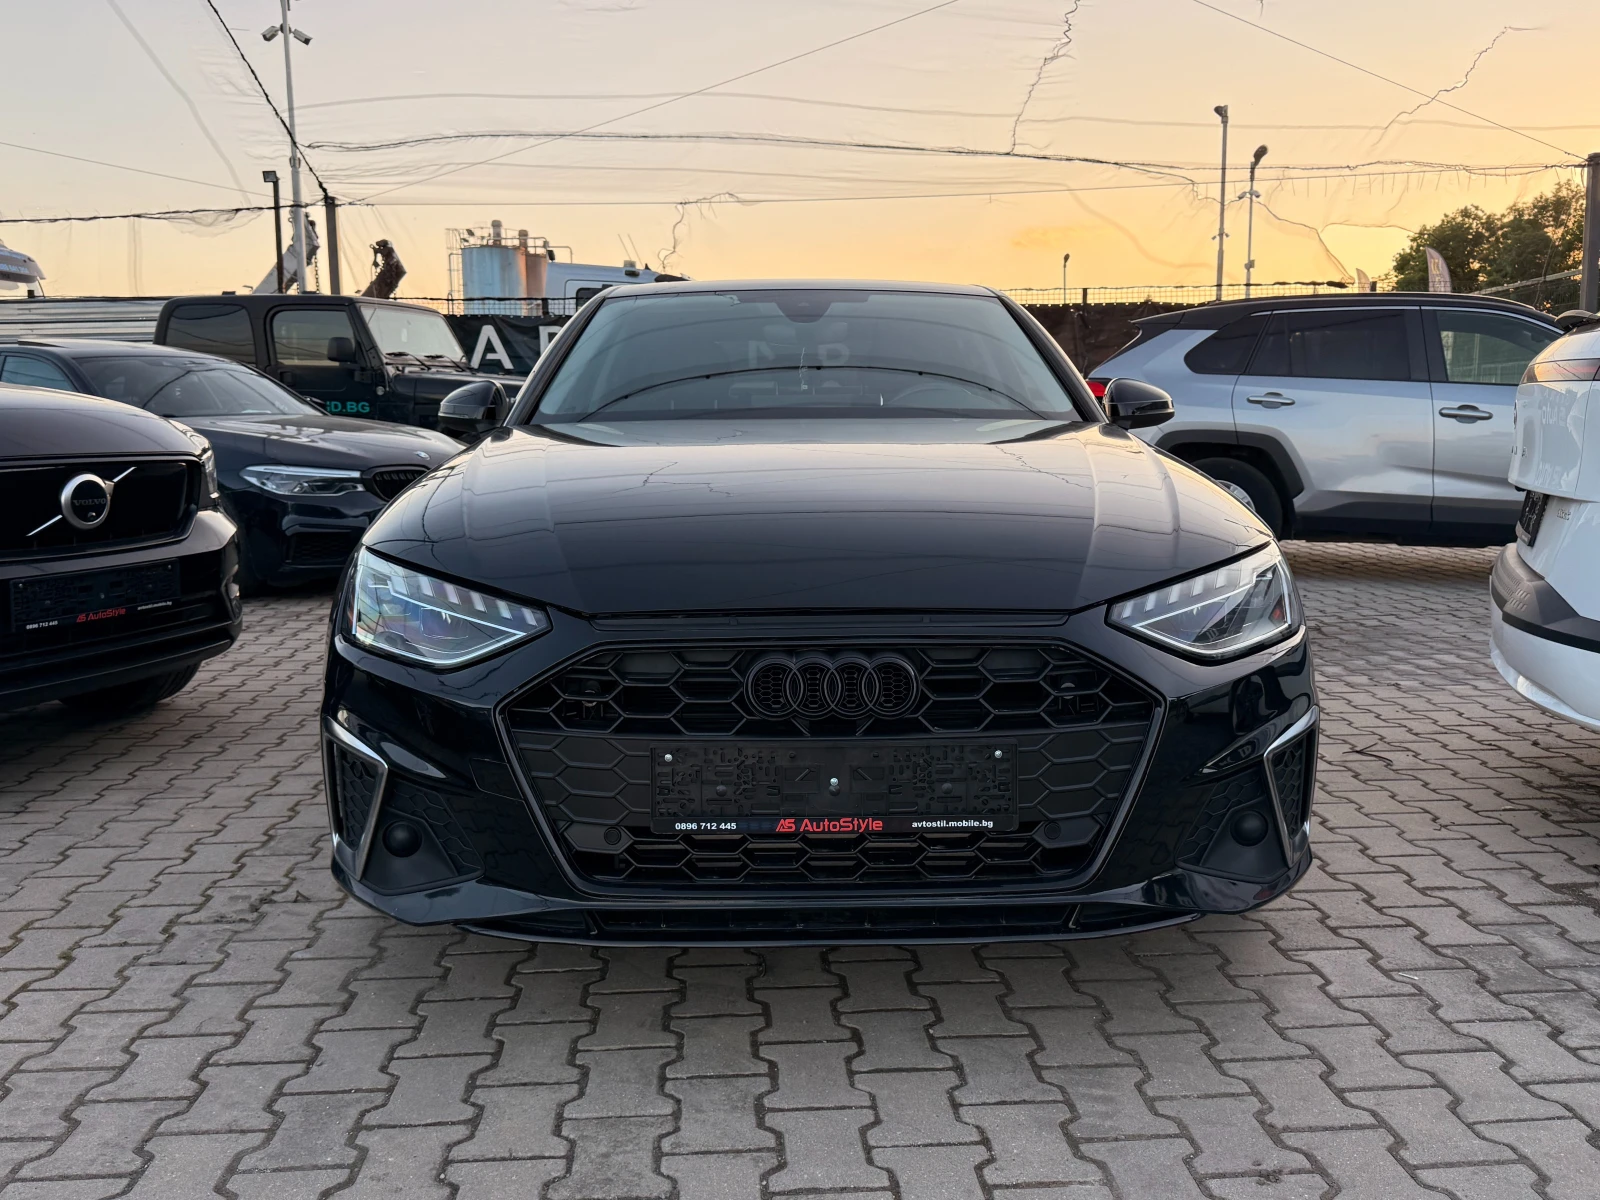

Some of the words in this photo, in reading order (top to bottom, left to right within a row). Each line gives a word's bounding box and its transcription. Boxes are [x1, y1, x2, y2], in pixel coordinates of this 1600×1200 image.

[72, 498, 107, 506] VOLVO
[87, 607, 126, 621] AutoStyle
[675, 822, 698, 830] 0896
[700, 822, 717, 830] 712
[719, 822, 737, 830] 445
[800, 817, 883, 833] AutoStyle
[911, 819, 994, 829] avtostil.mobile.bg
